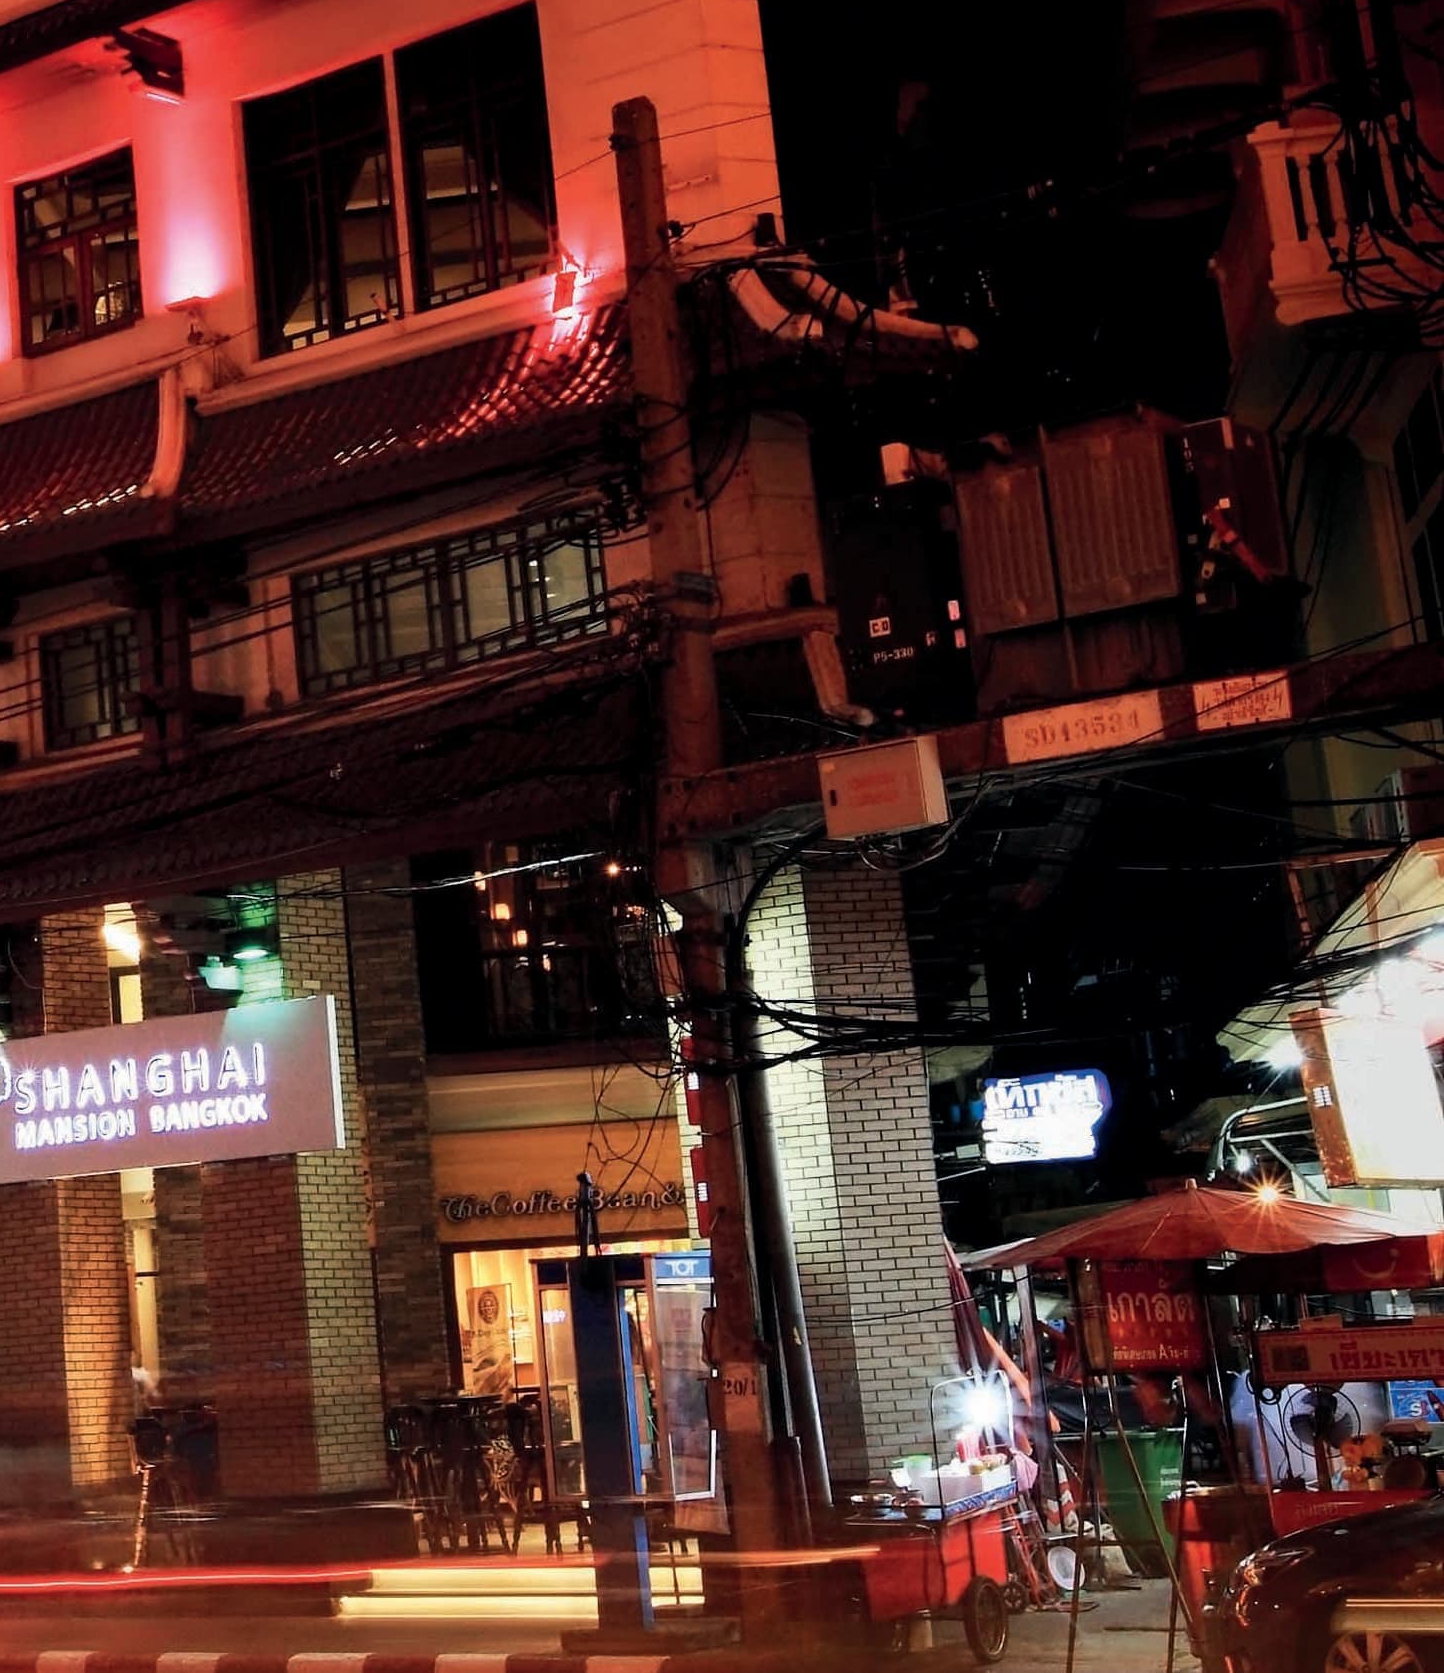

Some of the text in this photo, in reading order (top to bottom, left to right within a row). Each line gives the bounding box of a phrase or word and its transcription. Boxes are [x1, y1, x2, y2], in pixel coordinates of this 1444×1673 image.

[14, 1042, 267, 1115] SHANGHAI
[15, 1093, 268, 1150] MANSION BANGKOK
[665, 1260, 700, 1276] TOT
[1105, 1277, 1196, 1323] เกาลัด
